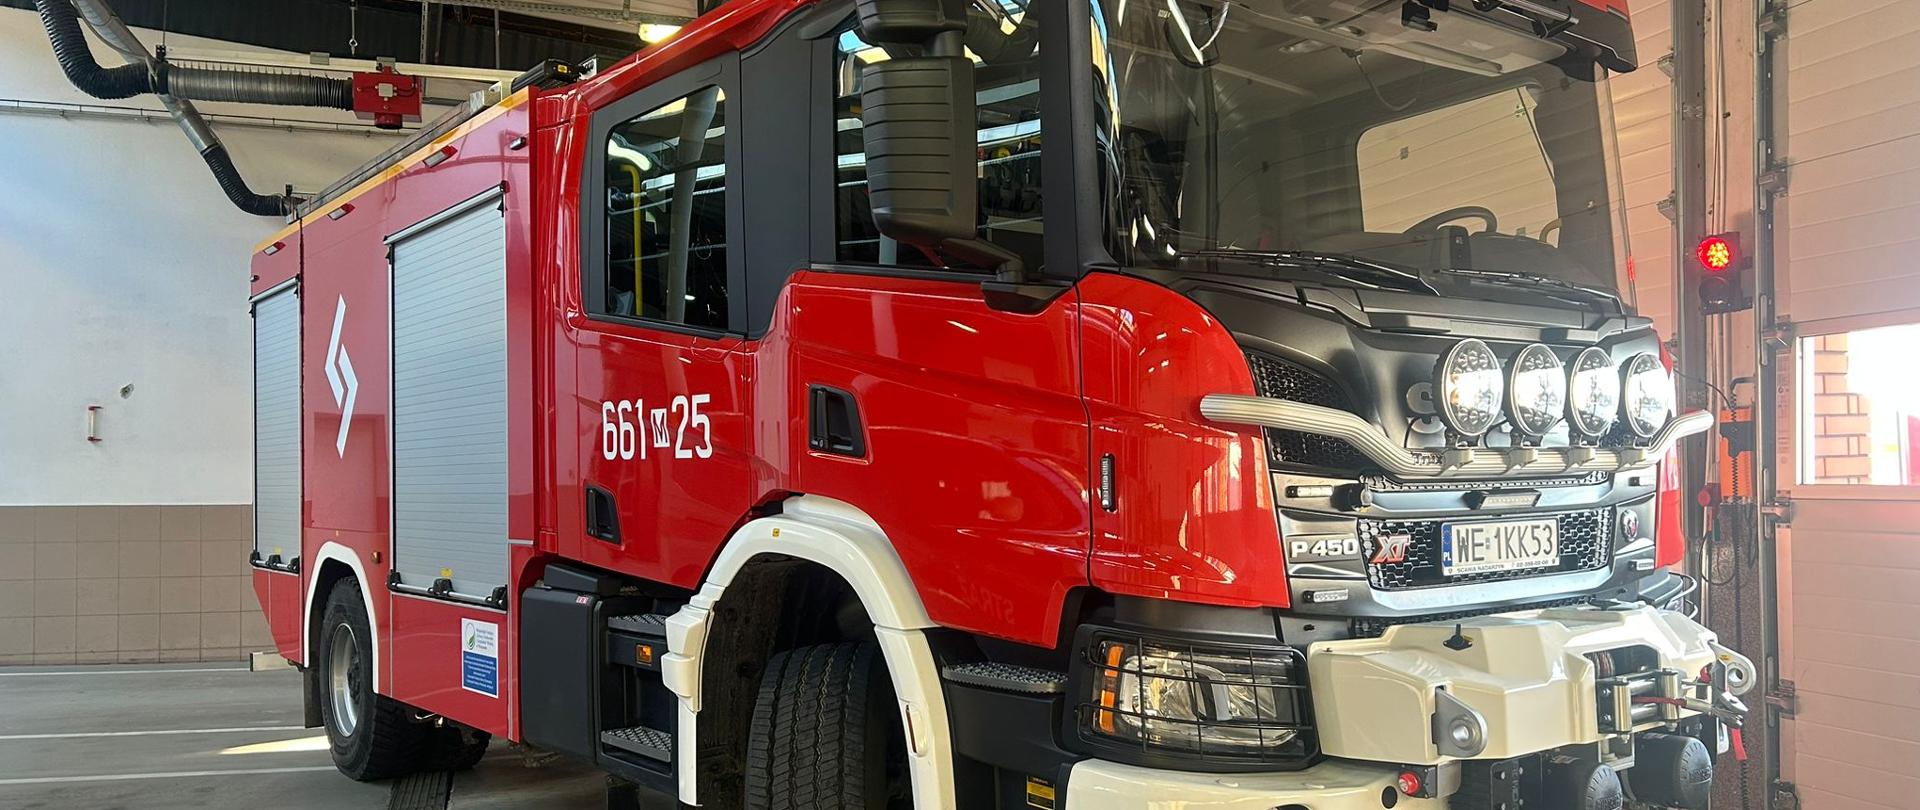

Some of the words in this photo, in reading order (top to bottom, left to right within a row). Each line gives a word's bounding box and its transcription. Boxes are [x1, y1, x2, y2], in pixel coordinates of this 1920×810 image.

[602, 398, 646, 460] 661
[652, 410, 669, 446] M
[671, 393, 713, 459] 25
[1291, 541, 1308, 558] P
[1310, 538, 1358, 557] 450
[1370, 534, 1411, 564] XT
[1443, 551, 1452, 562] PL
[1456, 527, 1485, 563] WE
[1494, 523, 1553, 560] 1KK53
